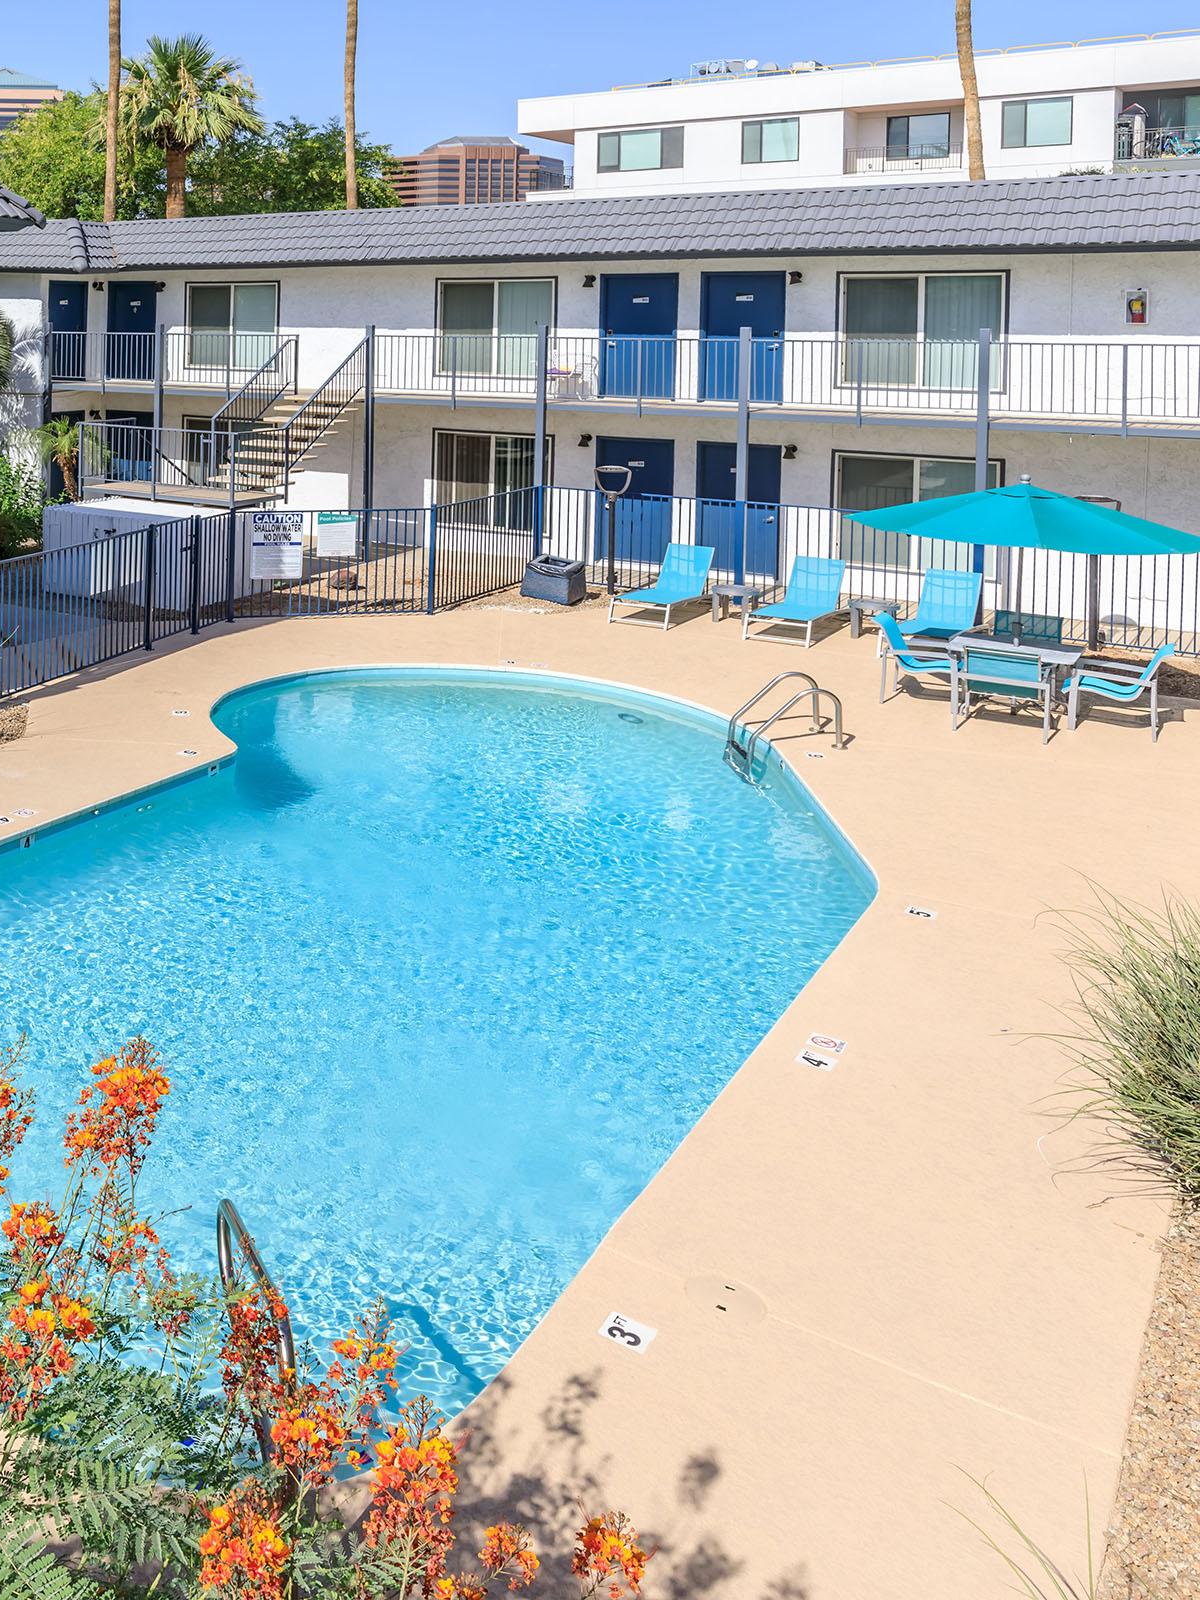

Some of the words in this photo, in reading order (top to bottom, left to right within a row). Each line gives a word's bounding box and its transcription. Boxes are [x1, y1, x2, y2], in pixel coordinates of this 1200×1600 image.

[255, 514, 302, 523] CAUTION
[254, 524, 282, 533] SHALLOW
[282, 524, 302, 532] WATER
[263, 533, 272, 541] NO
[273, 533, 292, 541] DIVING
[909, 909, 931, 917] 5
[802, 1056, 828, 1067] 4
[613, 1315, 628, 1328] FT
[607, 1326, 642, 1346] 3
